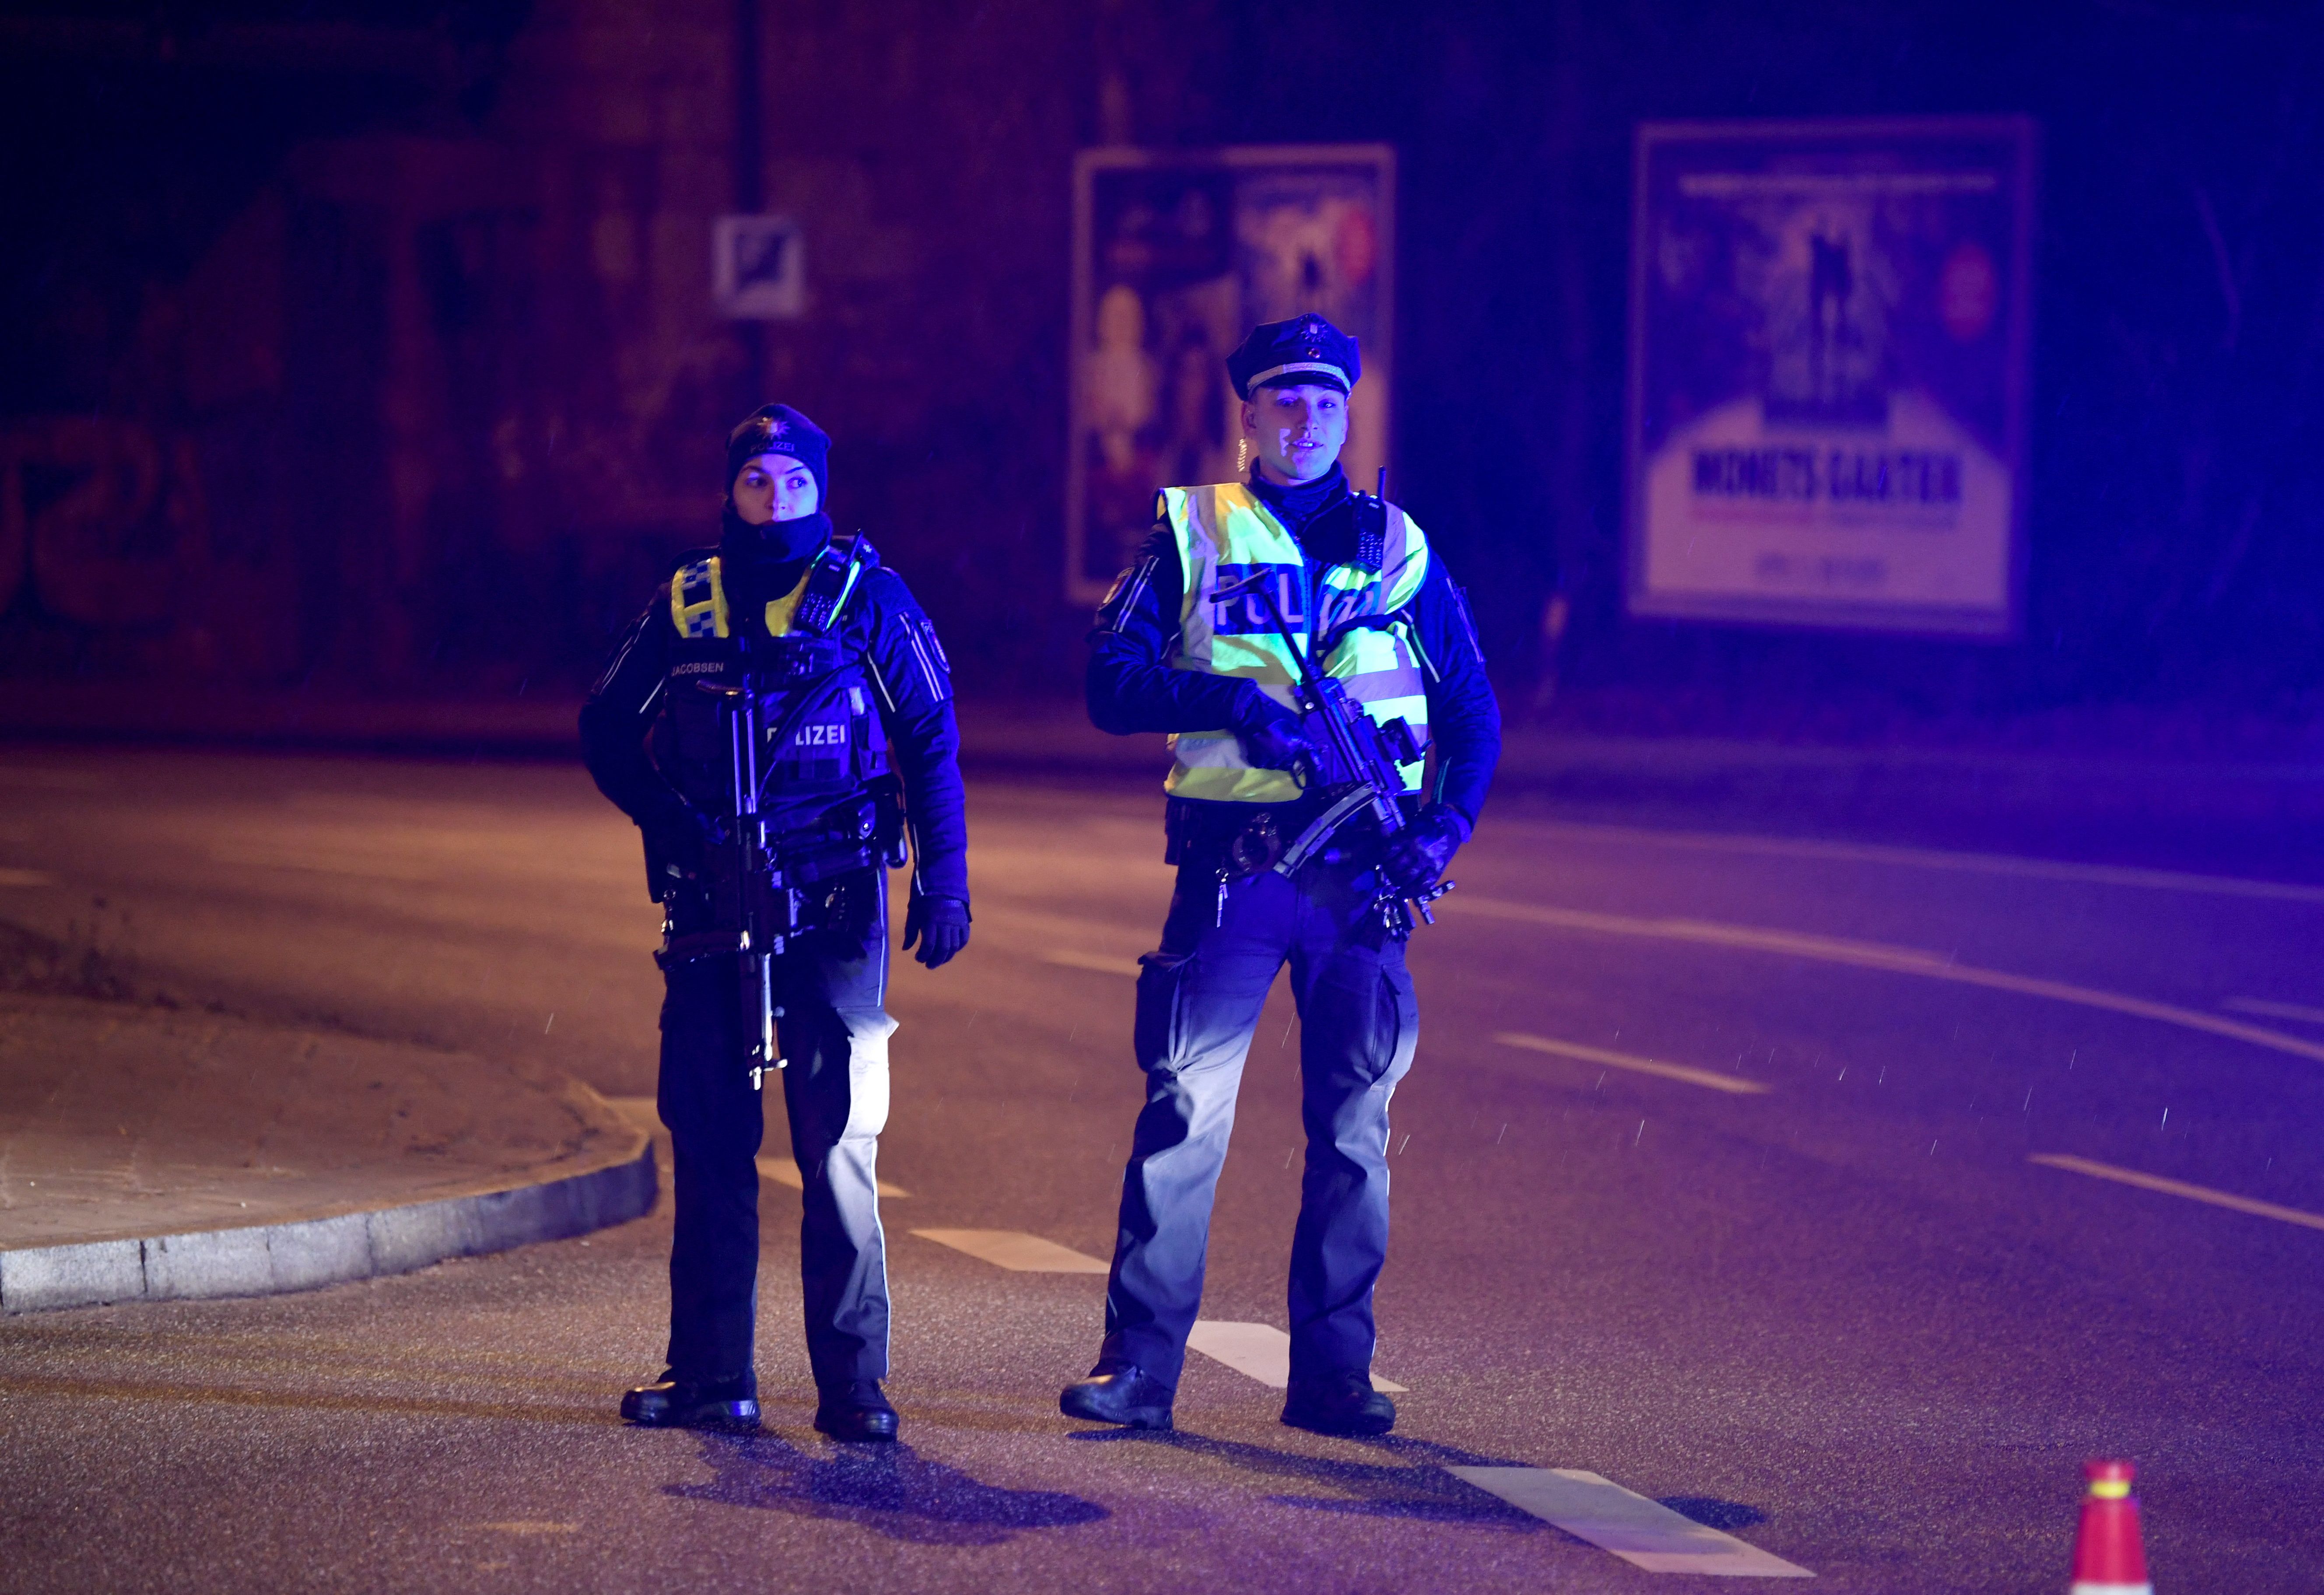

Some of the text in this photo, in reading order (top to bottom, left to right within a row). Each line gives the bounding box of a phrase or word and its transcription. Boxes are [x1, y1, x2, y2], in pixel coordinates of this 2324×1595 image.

[750, 441, 795, 454] POLIZEI
[671, 661, 724, 677] JACOBSEN
[767, 724, 845, 746] PLIZEI
